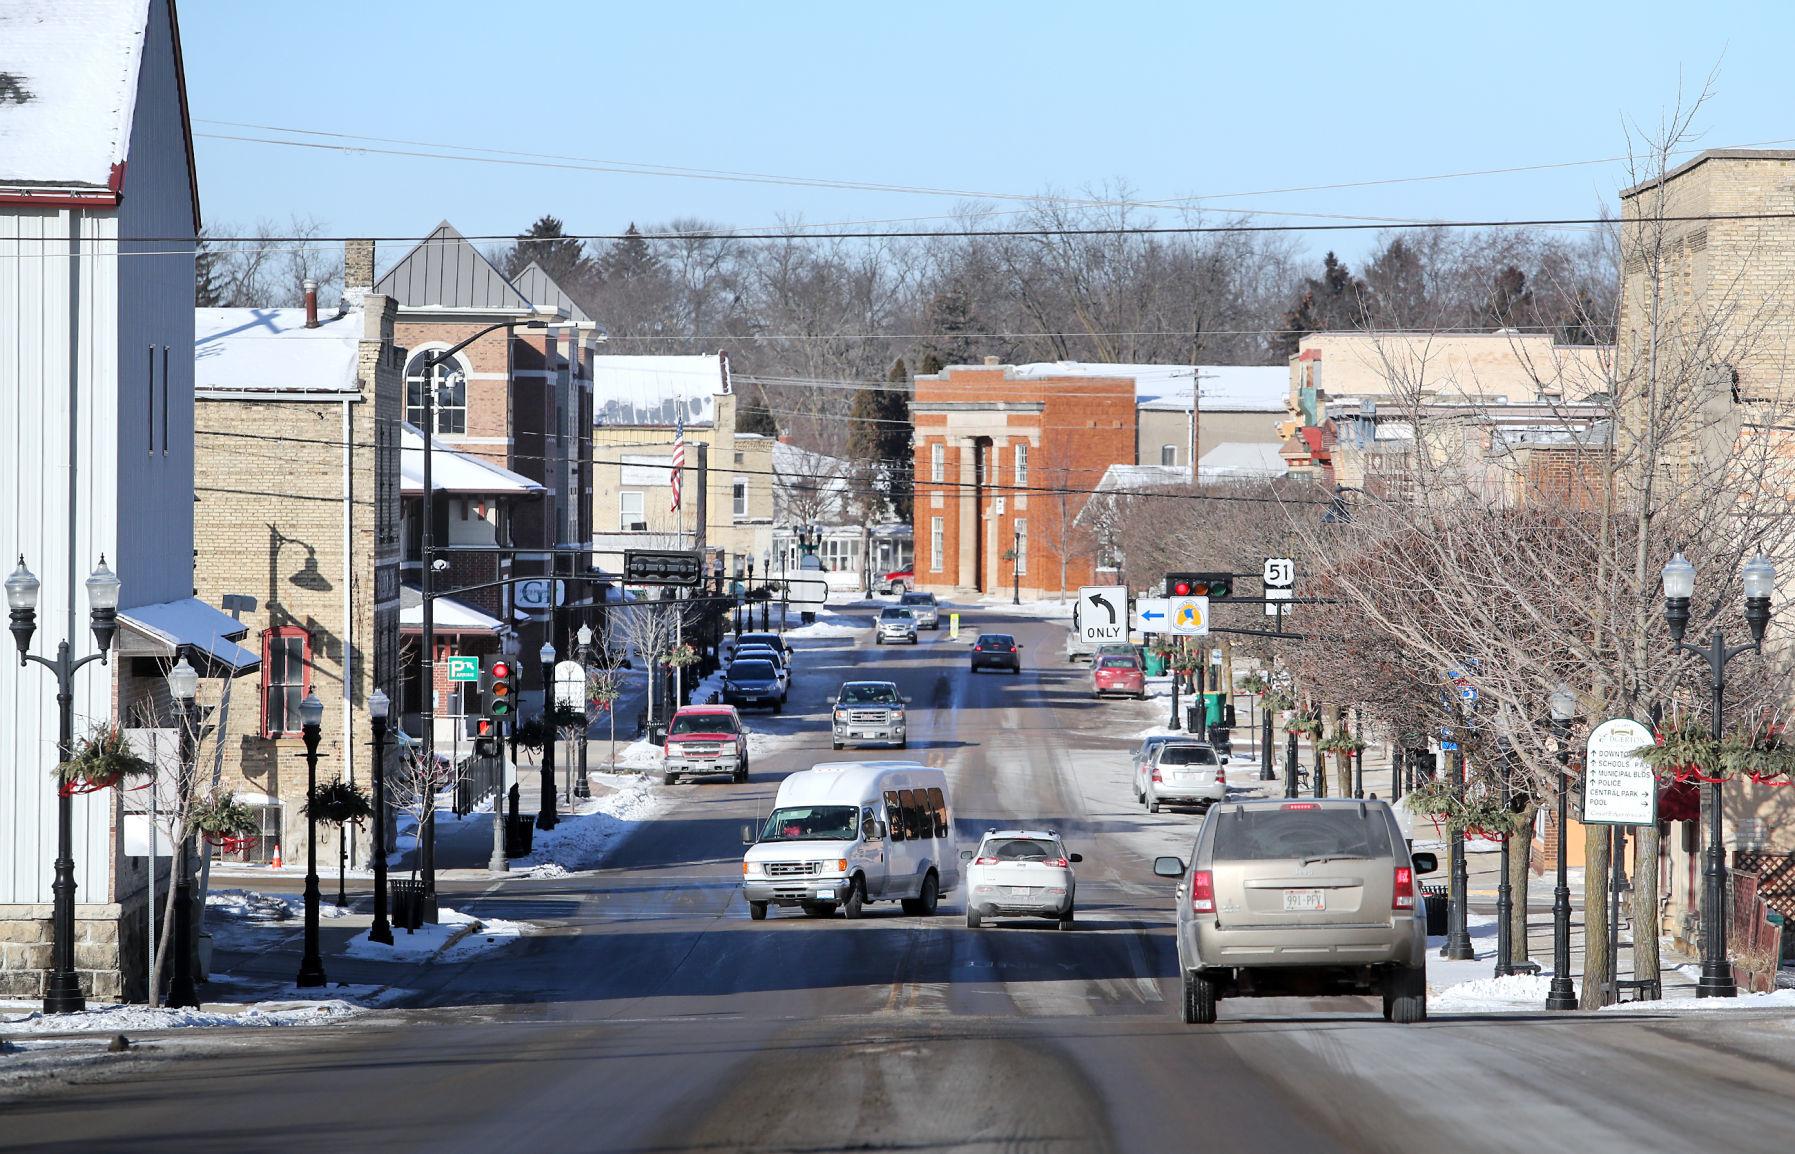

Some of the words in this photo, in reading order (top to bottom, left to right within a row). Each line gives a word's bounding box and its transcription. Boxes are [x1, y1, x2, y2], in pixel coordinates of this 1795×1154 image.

[1270, 565, 1288, 580] 51
[1087, 627, 1120, 638] ONLY
[1598, 760, 1630, 768] SCHOOLS
[1598, 770, 1632, 778] MUNICIPAL
[1598, 779, 1622, 787] POLICE
[1589, 789, 1620, 797] CENTRAL
[1589, 798, 1608, 806] POOL
